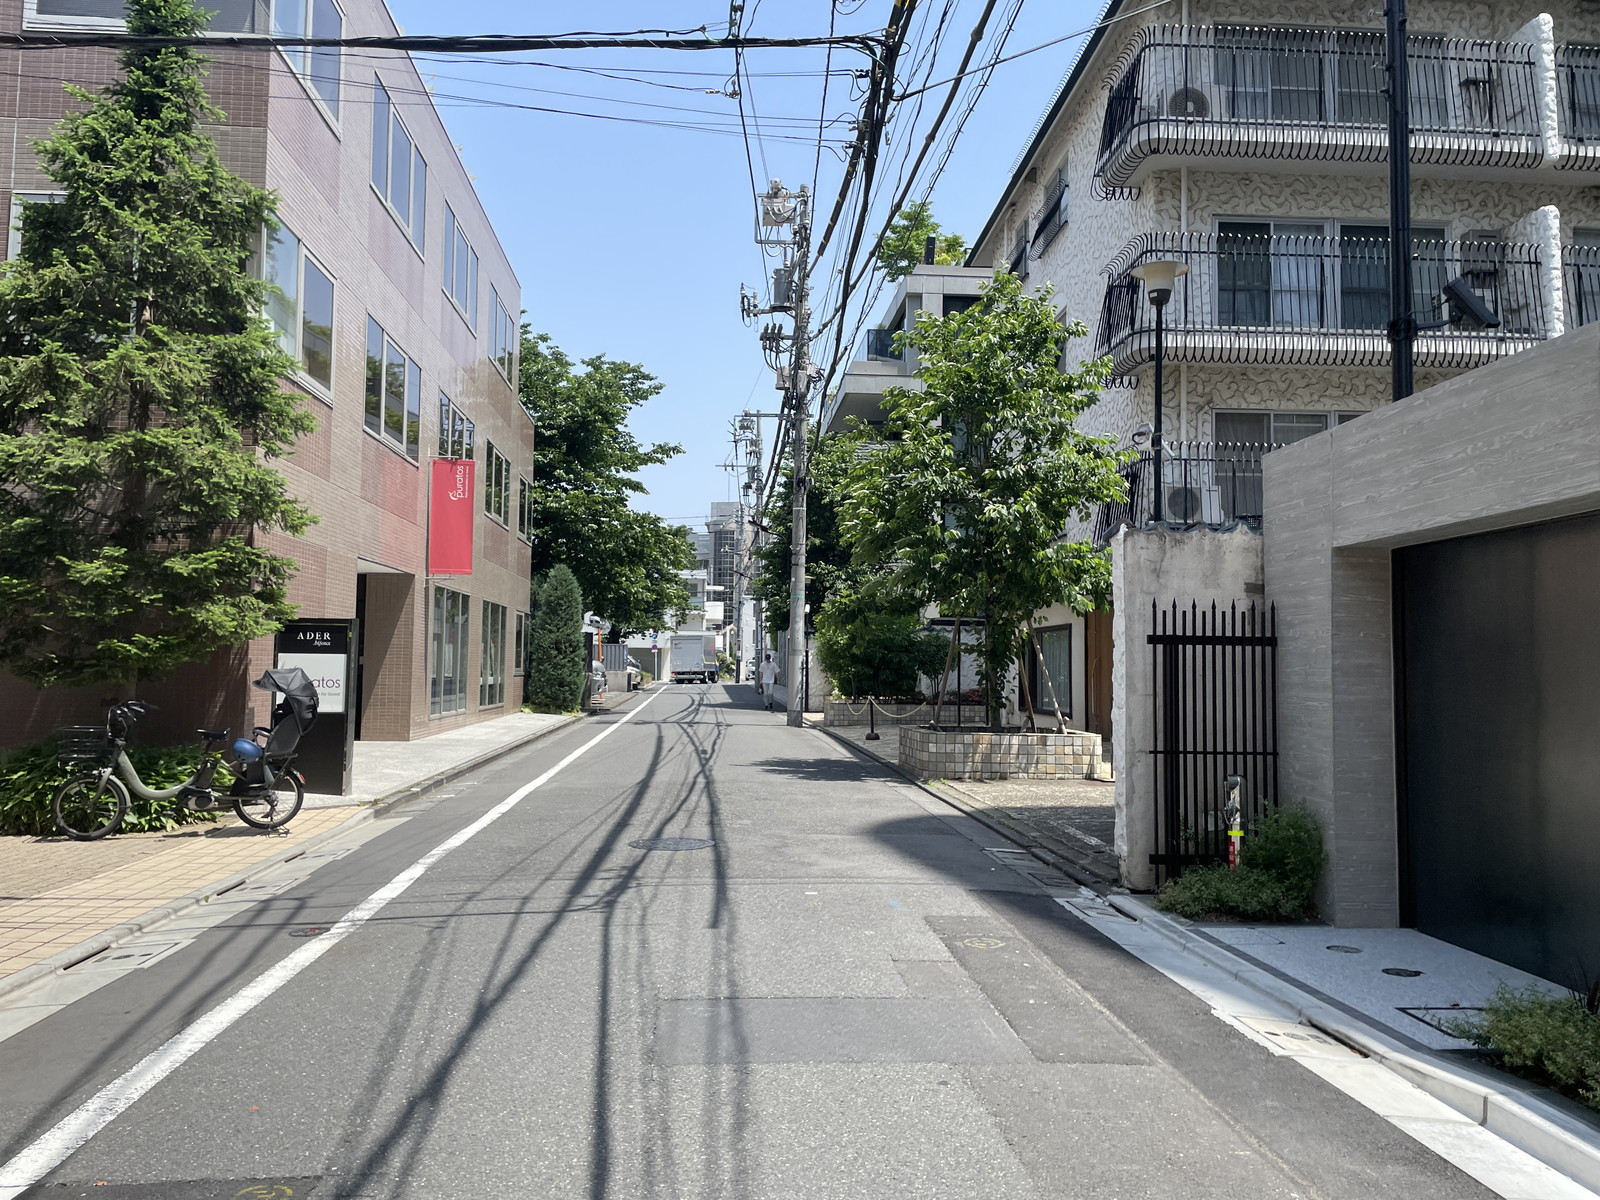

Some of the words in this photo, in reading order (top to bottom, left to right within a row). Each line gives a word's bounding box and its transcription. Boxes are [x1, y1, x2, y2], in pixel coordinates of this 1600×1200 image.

[455, 465, 464, 498] puratos
[297, 631, 331, 640] ADER
[313, 676, 341, 689] atos
